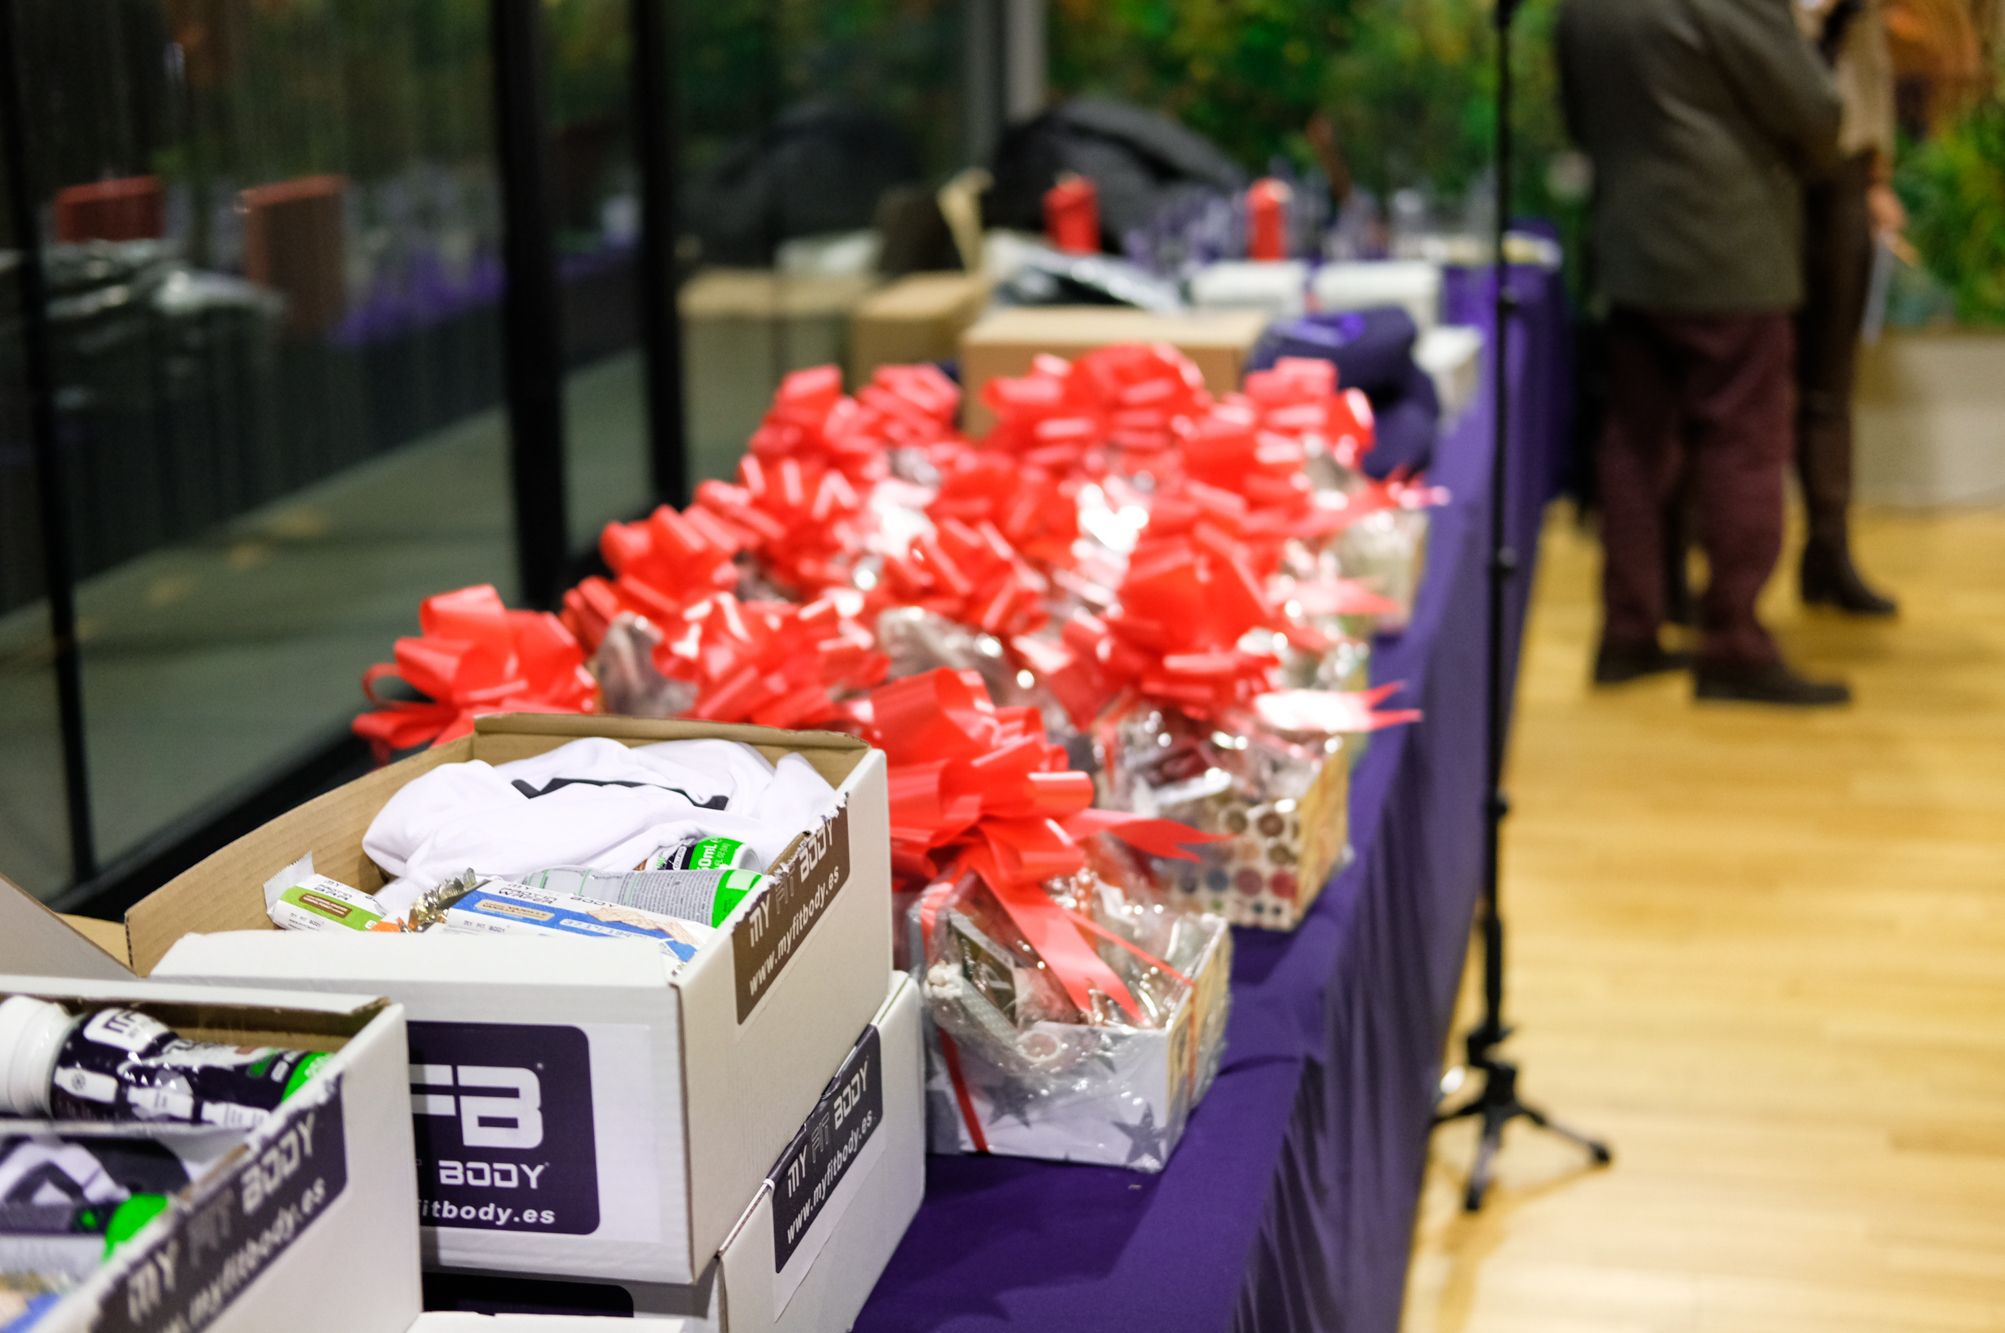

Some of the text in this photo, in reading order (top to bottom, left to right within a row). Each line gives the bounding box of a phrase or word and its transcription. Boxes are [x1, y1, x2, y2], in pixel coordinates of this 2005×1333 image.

[749, 865, 840, 996] www.myfitbody.es
[750, 892, 771, 948] MY
[799, 816, 834, 884] BODY
[408, 1063, 543, 1149] FB
[787, 1144, 808, 1199] MY
[833, 1060, 869, 1131] BODY
[127, 1239, 179, 1326] MY
[239, 1111, 316, 1215] BODY
[438, 1159, 547, 1189] BODY
[787, 1109, 873, 1245] www.myfitbody.es
